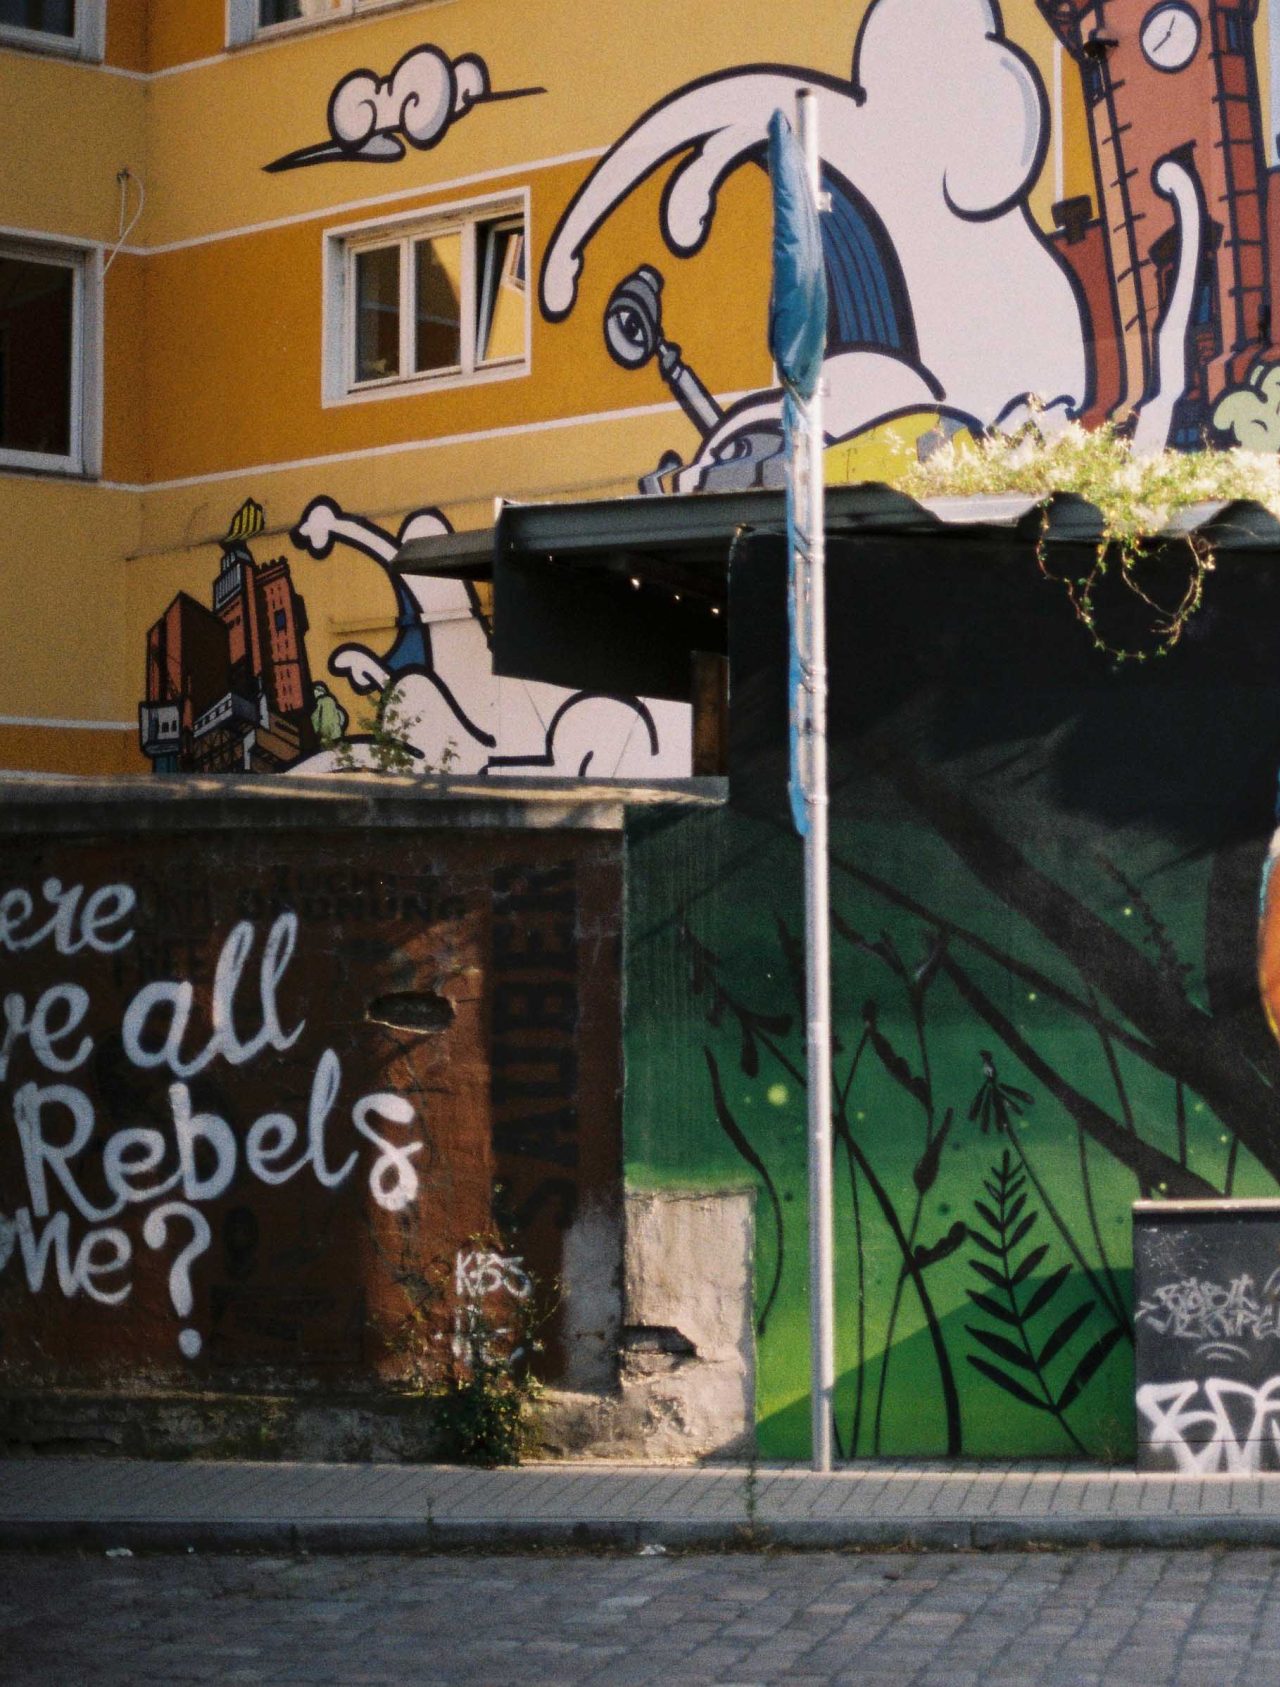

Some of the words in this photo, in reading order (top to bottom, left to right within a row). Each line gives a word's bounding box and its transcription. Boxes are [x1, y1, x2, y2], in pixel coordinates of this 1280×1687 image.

[121, 912, 306, 1077] all
[491, 859, 578, 1231] SAUBER
[13, 1048, 424, 1222] Rebels
